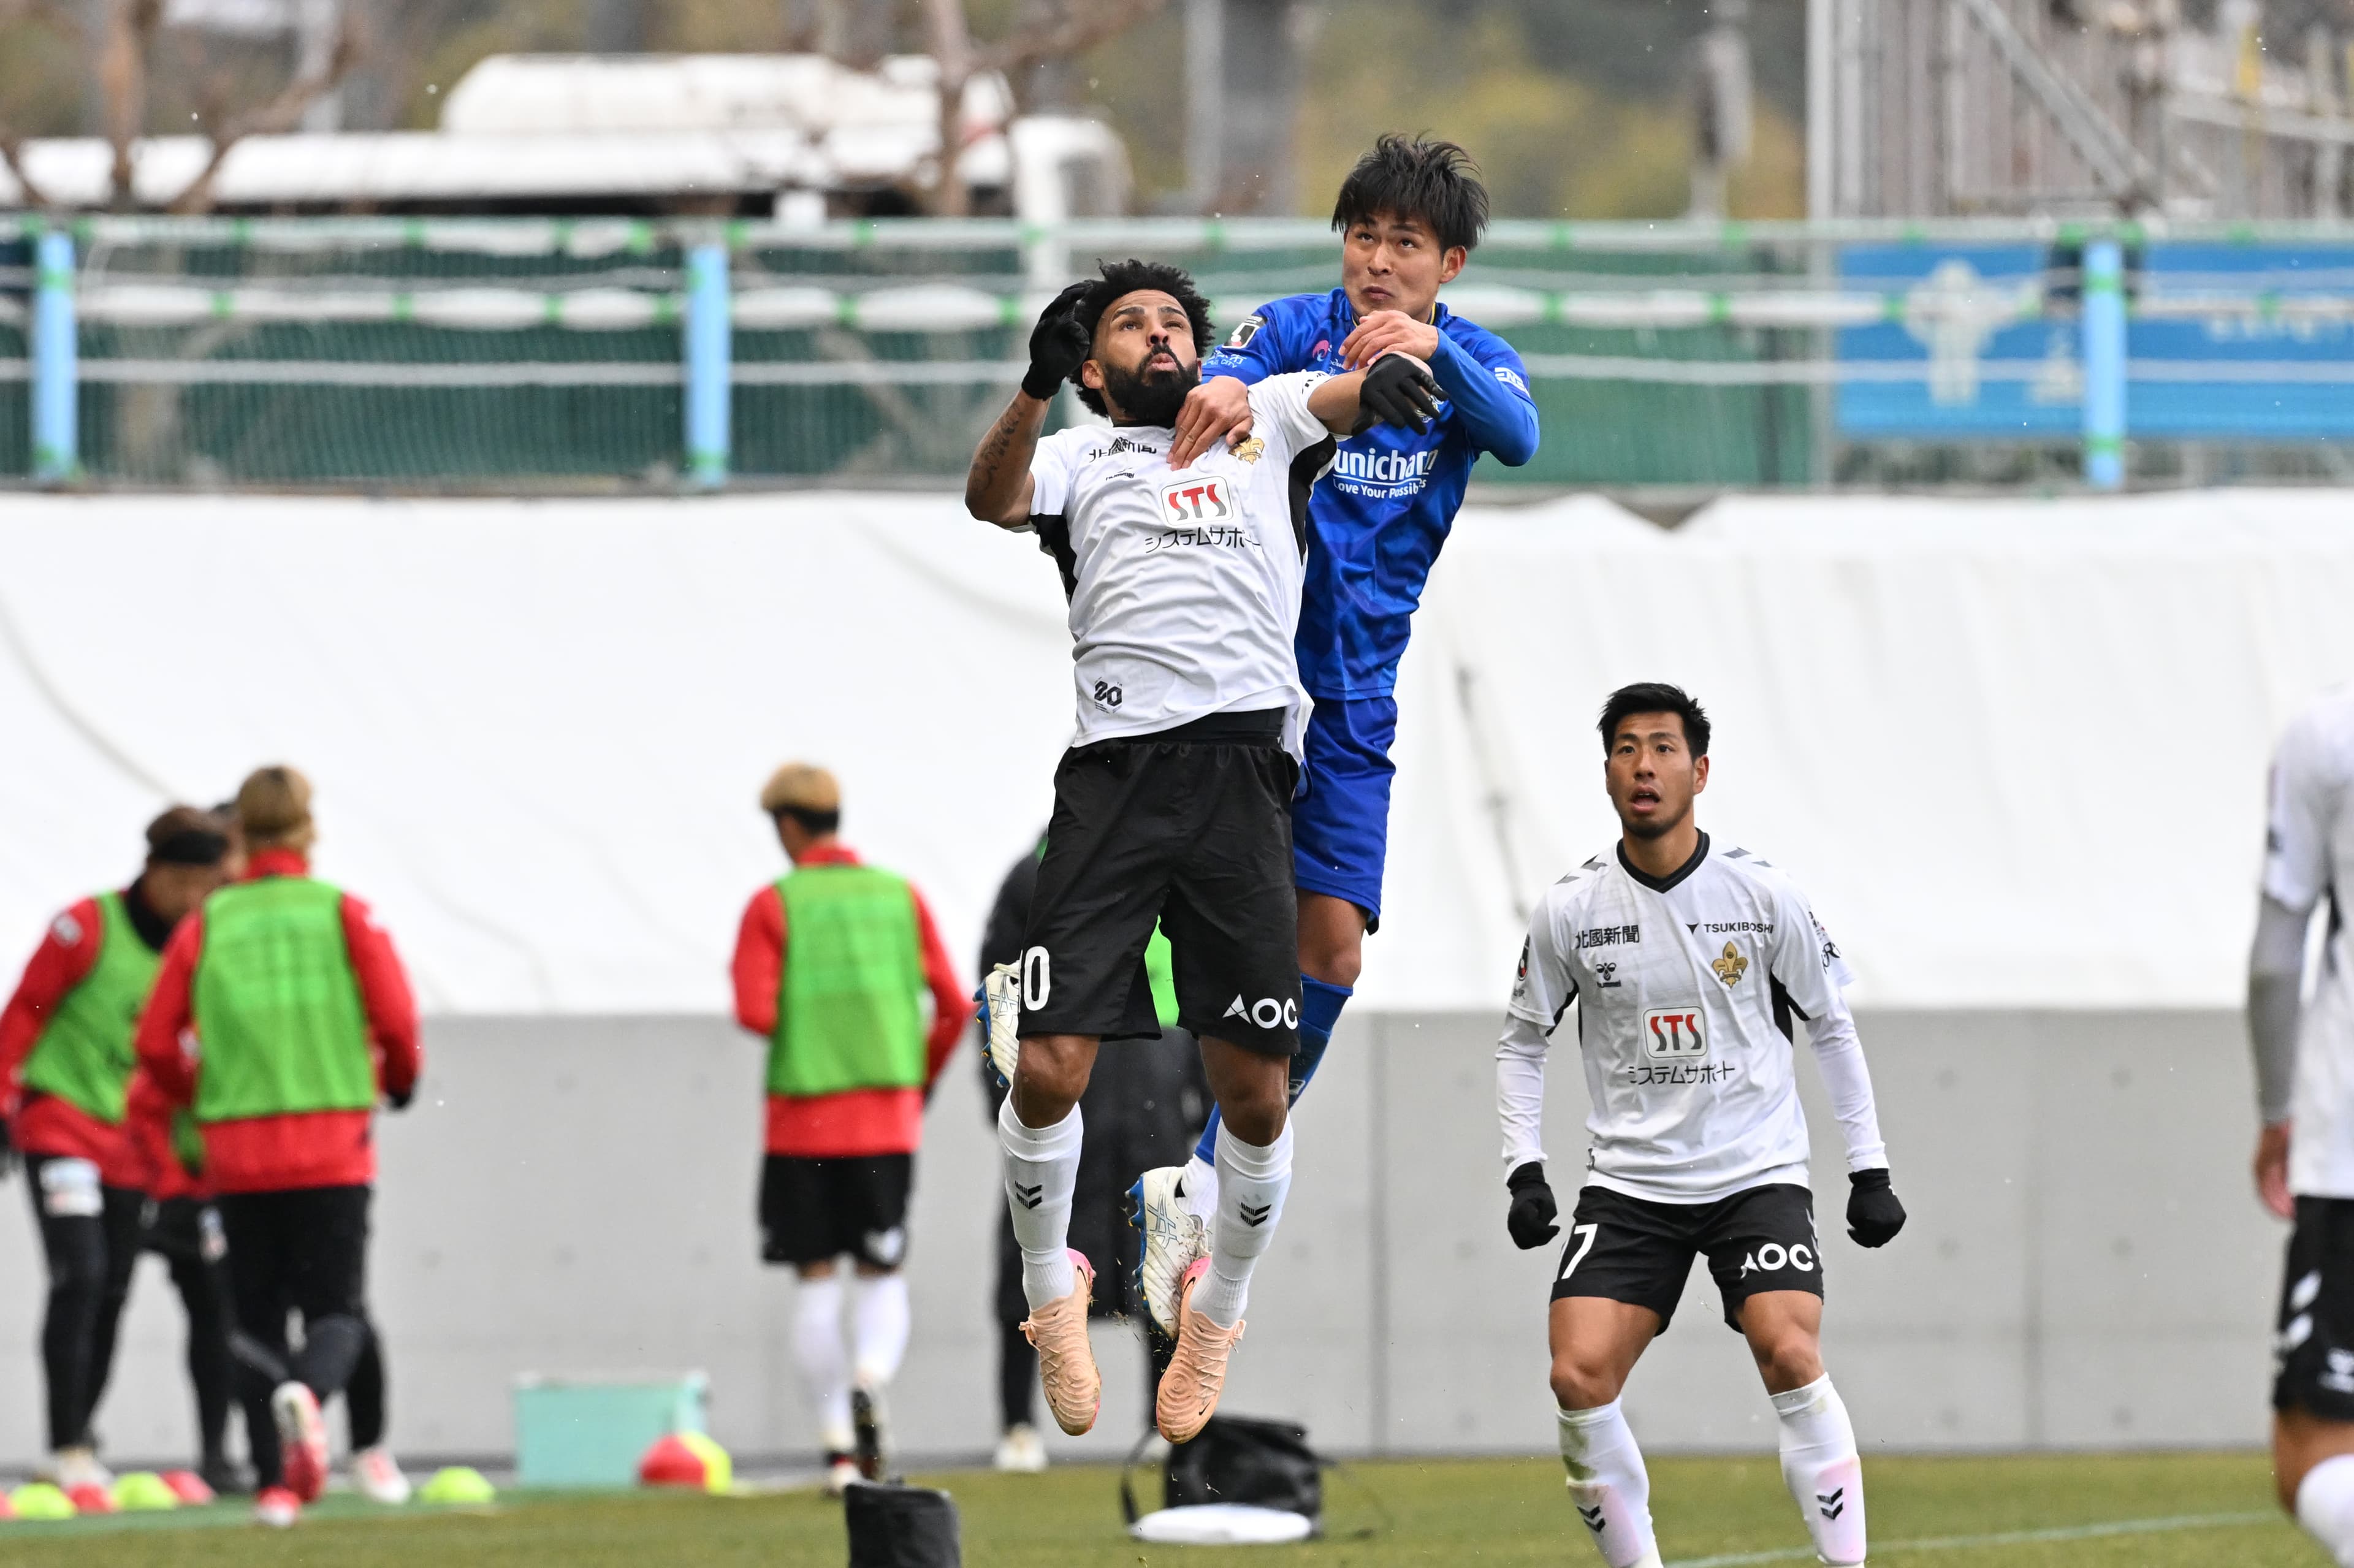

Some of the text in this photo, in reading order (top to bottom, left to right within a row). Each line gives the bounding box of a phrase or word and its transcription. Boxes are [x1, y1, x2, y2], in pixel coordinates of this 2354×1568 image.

[1168, 484, 1227, 521] STS
[1360, 484, 1387, 499] Your
[1094, 680, 1122, 707] 20
[1575, 924, 1640, 949] 北國新聞
[1704, 921, 1774, 934] TSUKIBOSHI
[1018, 946, 1051, 1011] 0
[1650, 1014, 1702, 1052] STS
[1628, 1060, 1735, 1085] システムサポート
